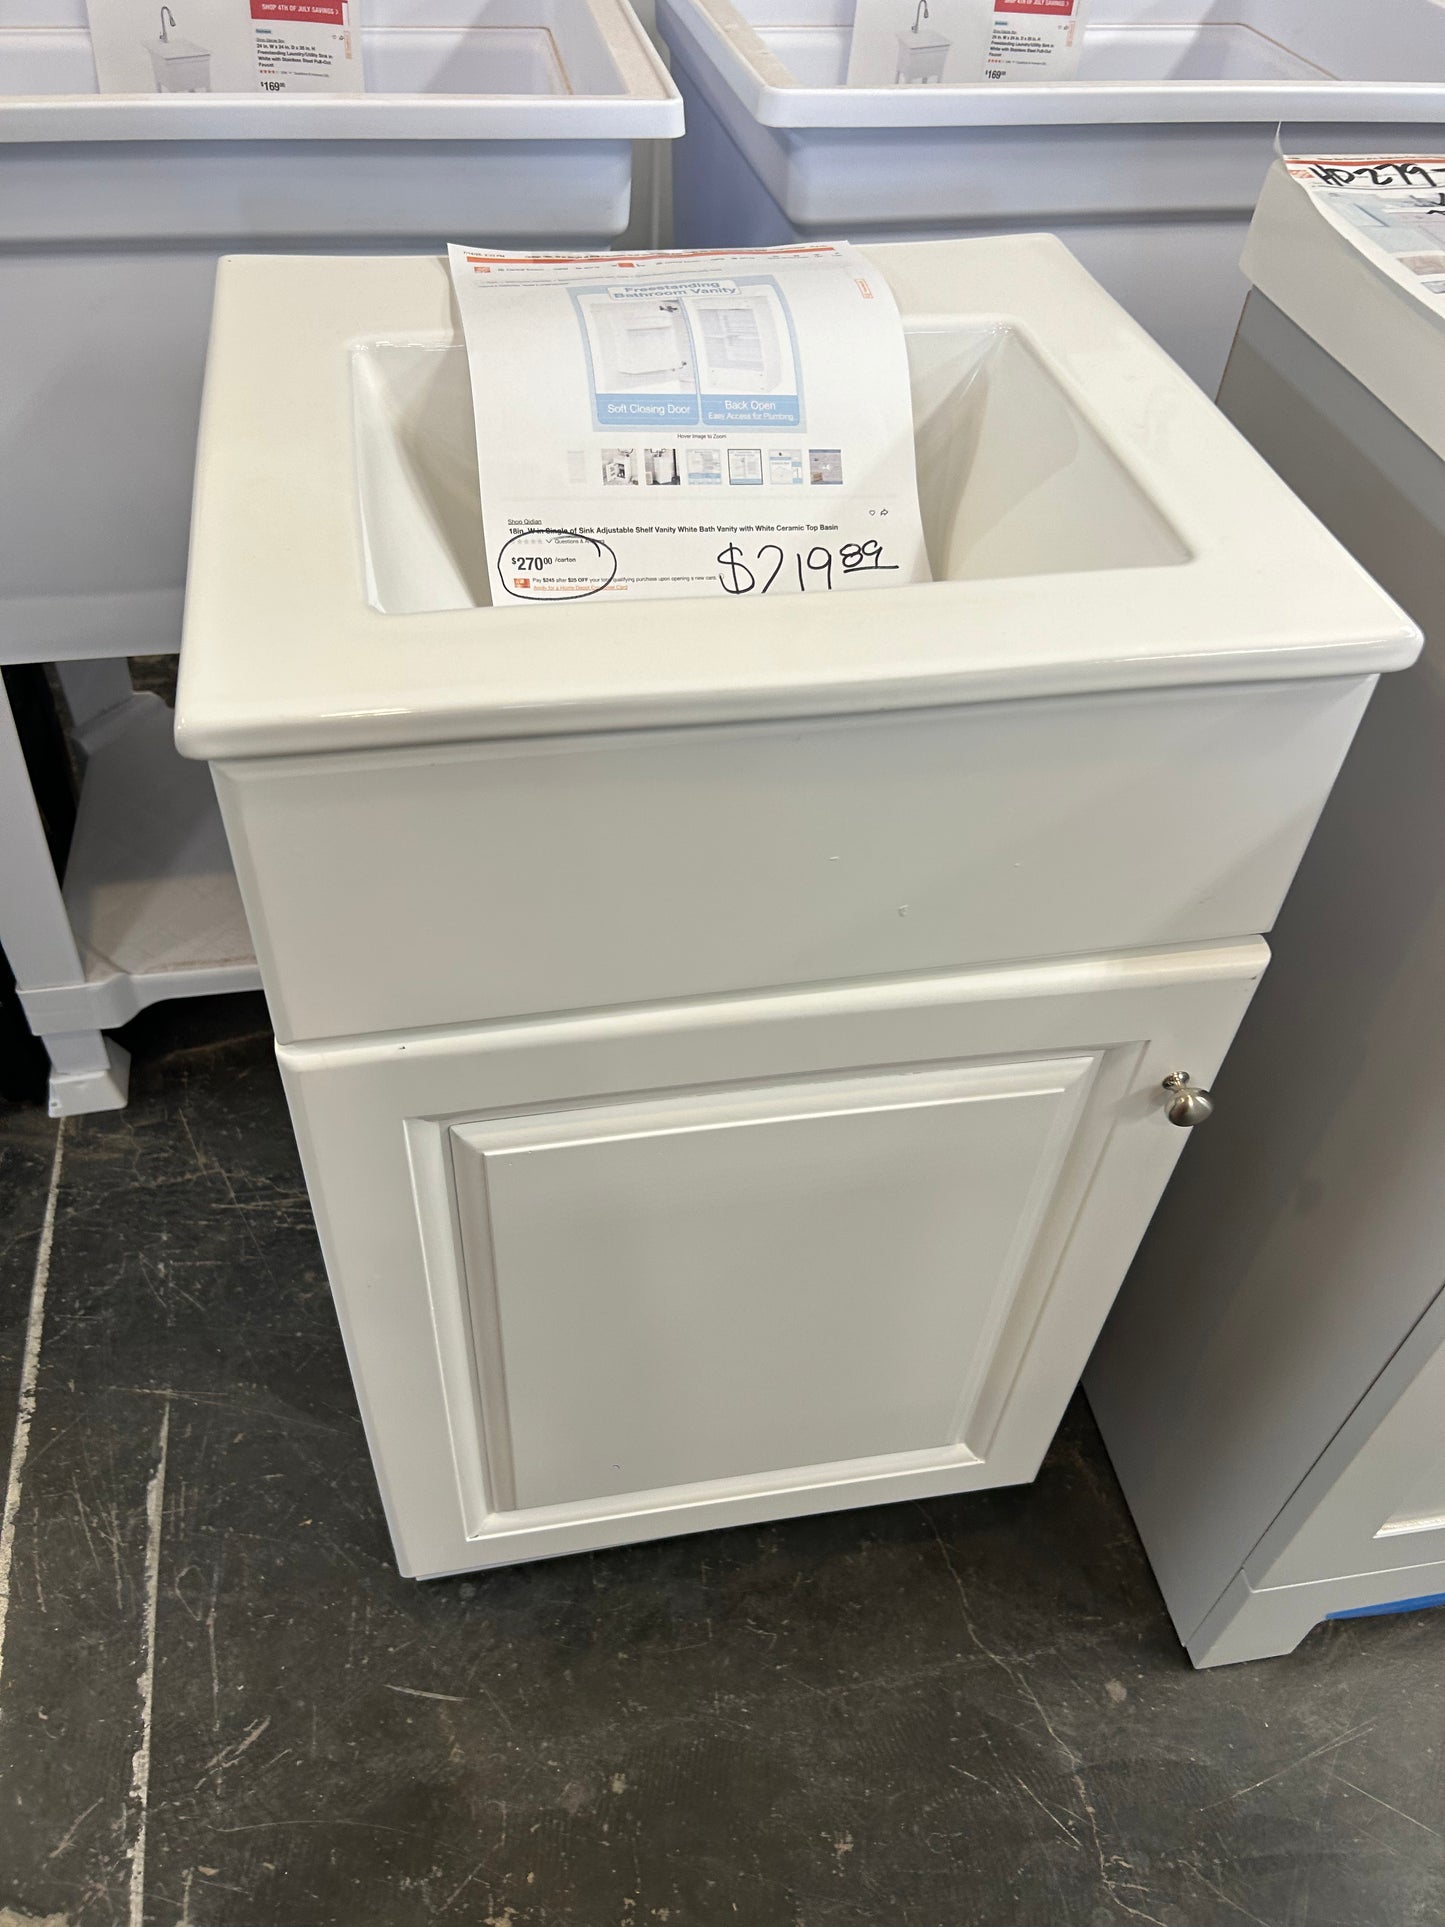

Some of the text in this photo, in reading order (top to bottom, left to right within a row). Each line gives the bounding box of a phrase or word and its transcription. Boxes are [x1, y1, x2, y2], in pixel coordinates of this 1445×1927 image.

[625, 282, 720, 292] Freestanding
[613, 290, 687, 298] Bathroom
[608, 403, 690, 415] Soft Closing Door
[725, 400, 776, 410] Back Open
